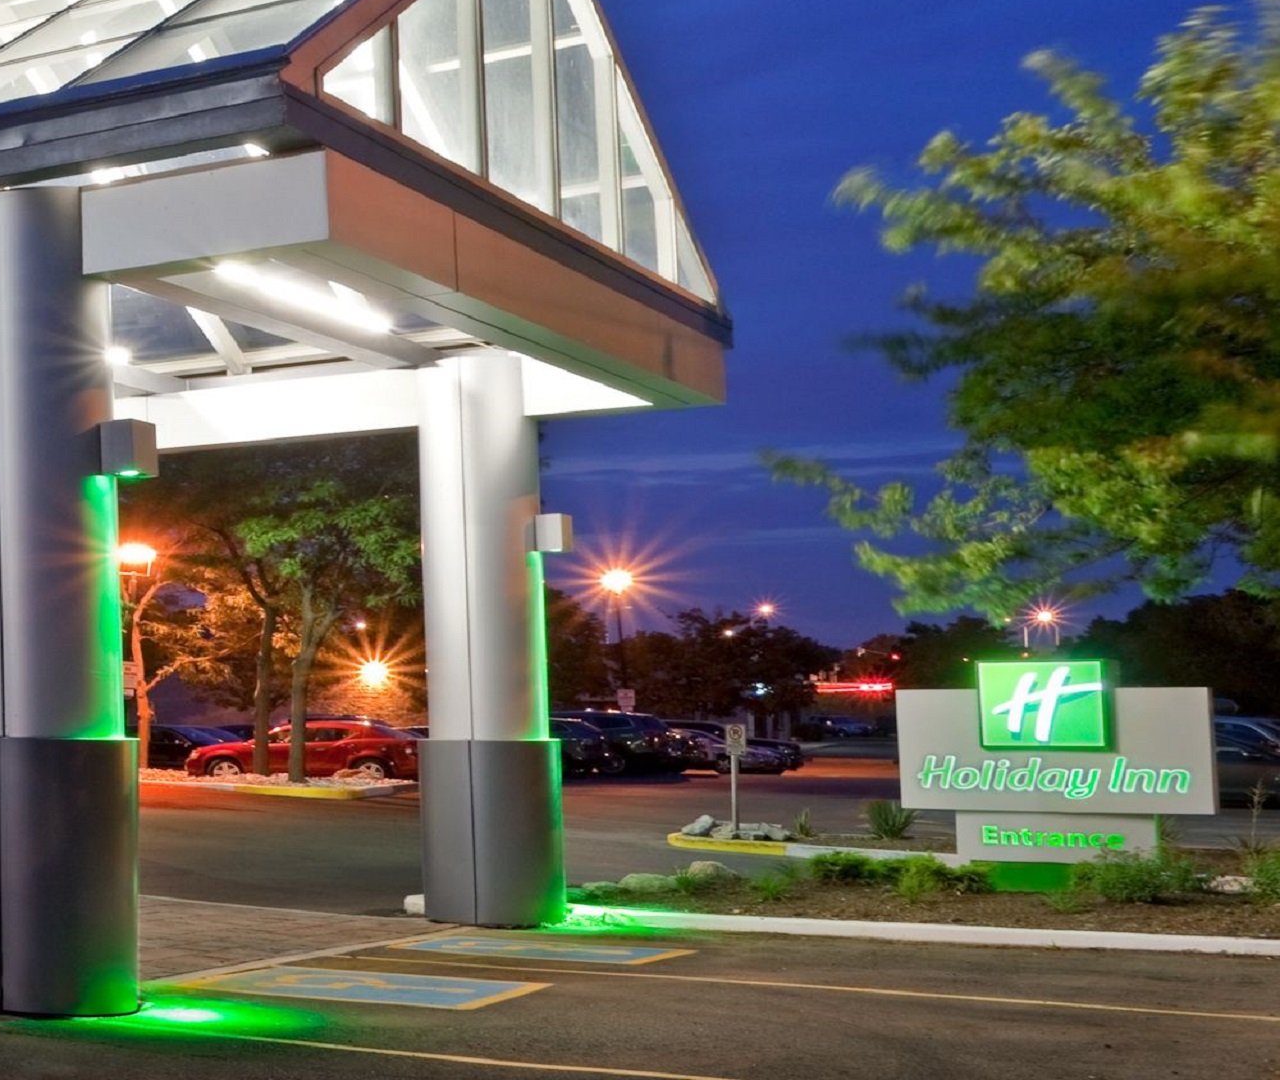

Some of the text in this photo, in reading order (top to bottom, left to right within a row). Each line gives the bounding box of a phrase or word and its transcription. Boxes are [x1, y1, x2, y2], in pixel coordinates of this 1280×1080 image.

[919, 755, 1191, 800] Holiday Inn
[981, 825, 1126, 850] Entrance
